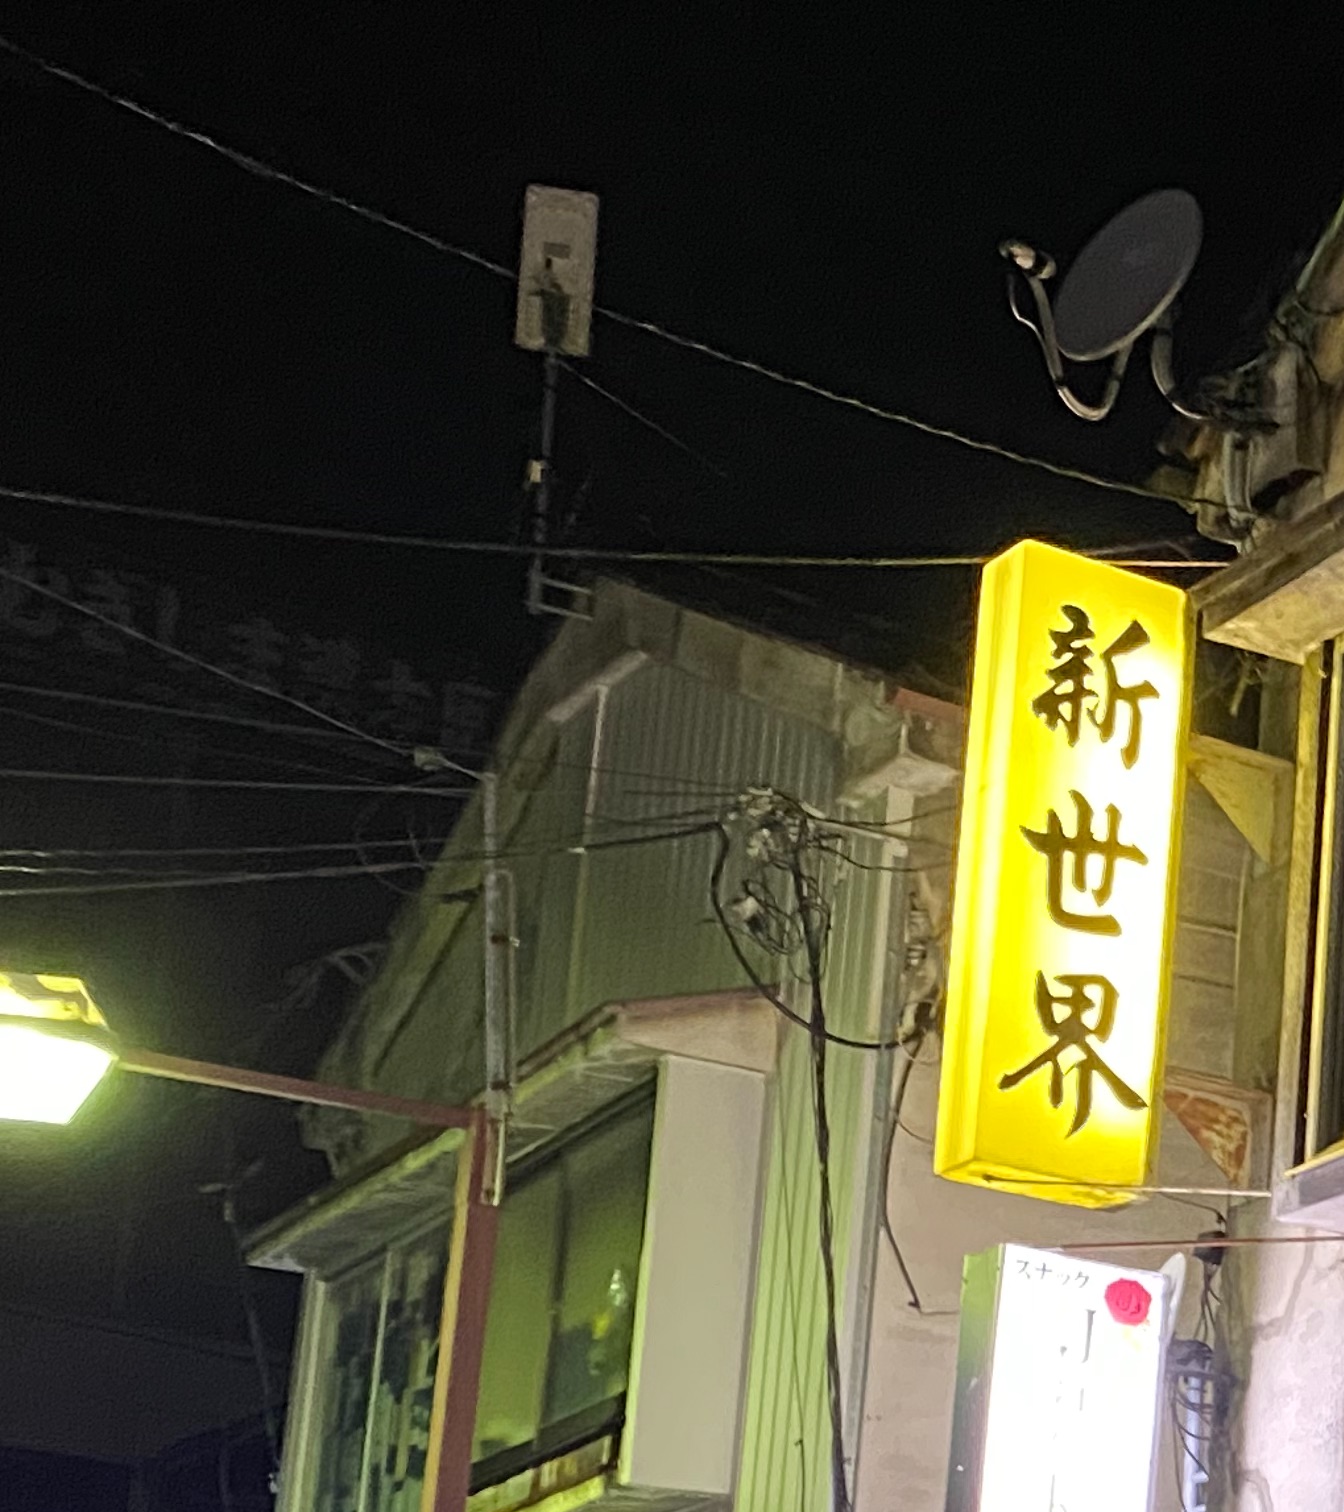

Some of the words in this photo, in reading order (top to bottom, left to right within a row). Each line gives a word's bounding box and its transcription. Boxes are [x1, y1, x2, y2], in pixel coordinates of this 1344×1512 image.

[999, 604, 1159, 1138] 新世界
[1016, 1258, 1090, 1289] スナック
